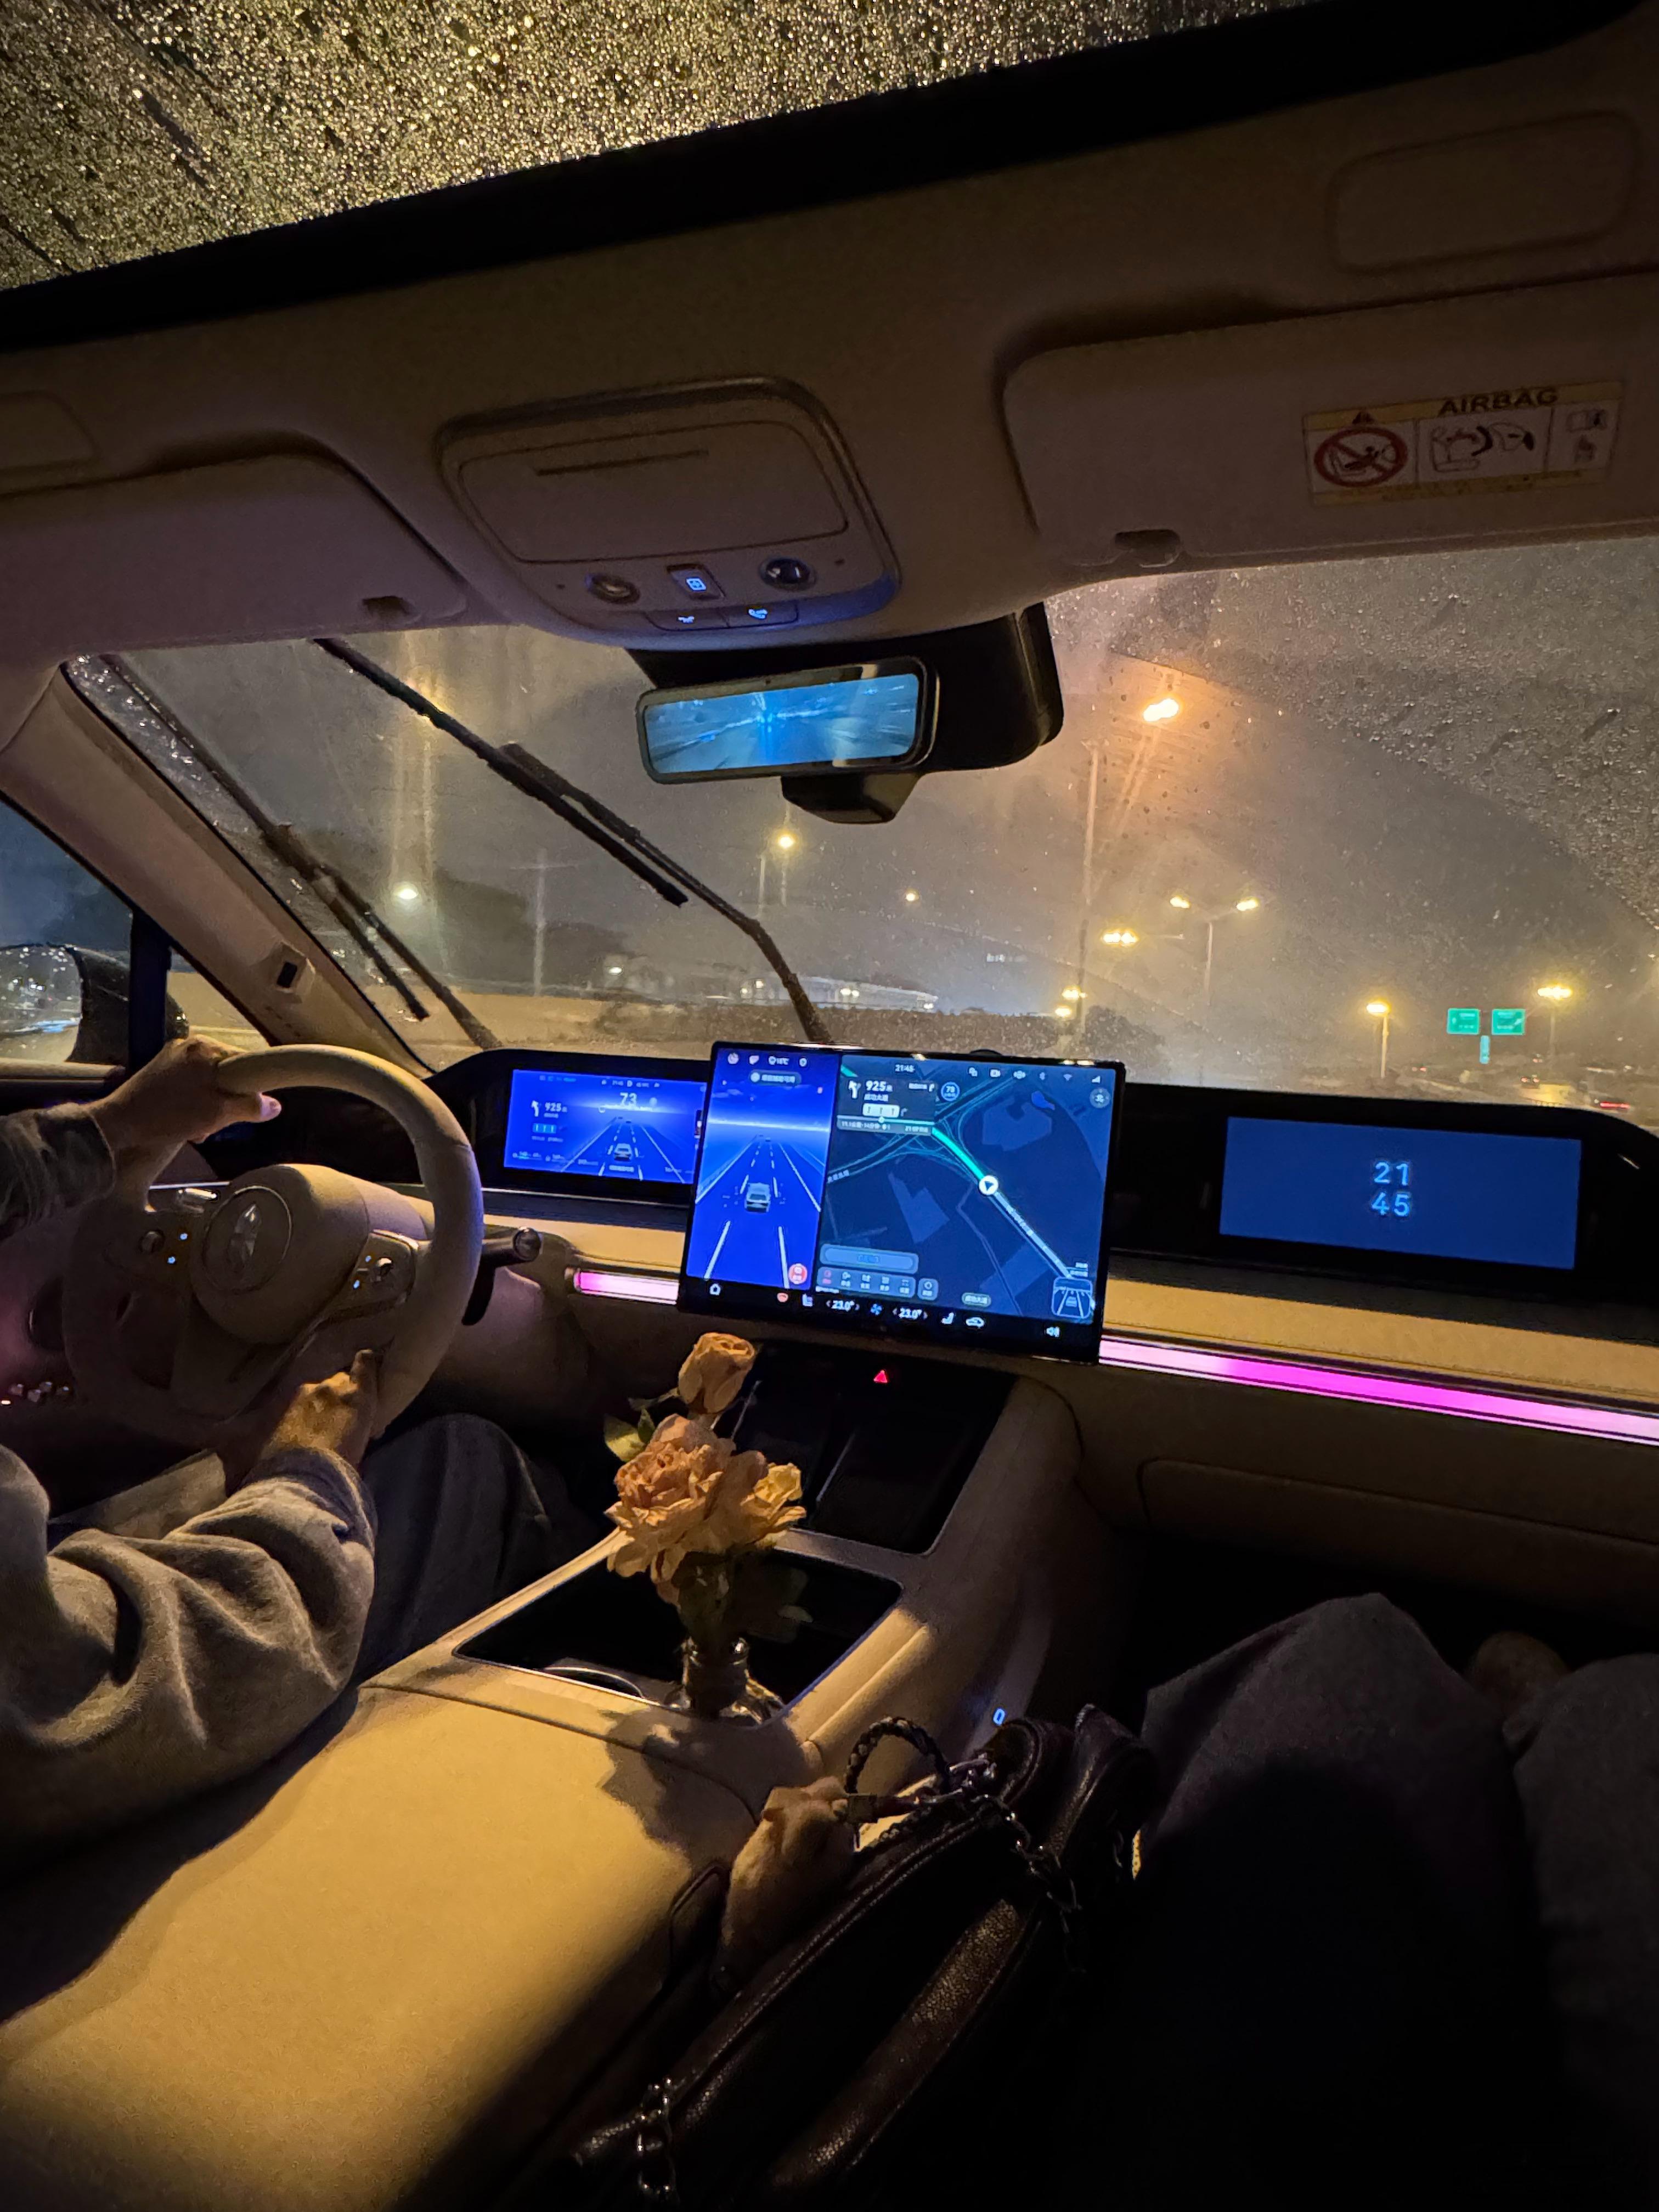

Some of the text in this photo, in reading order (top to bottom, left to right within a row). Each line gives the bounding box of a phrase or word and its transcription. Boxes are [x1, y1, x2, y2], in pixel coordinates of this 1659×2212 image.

[1437, 386, 1559, 416] AIRBAG
[619, 1092, 637, 1107] 73
[1373, 1161, 1409, 1186] 21
[1371, 1192, 1410, 1217] 45
